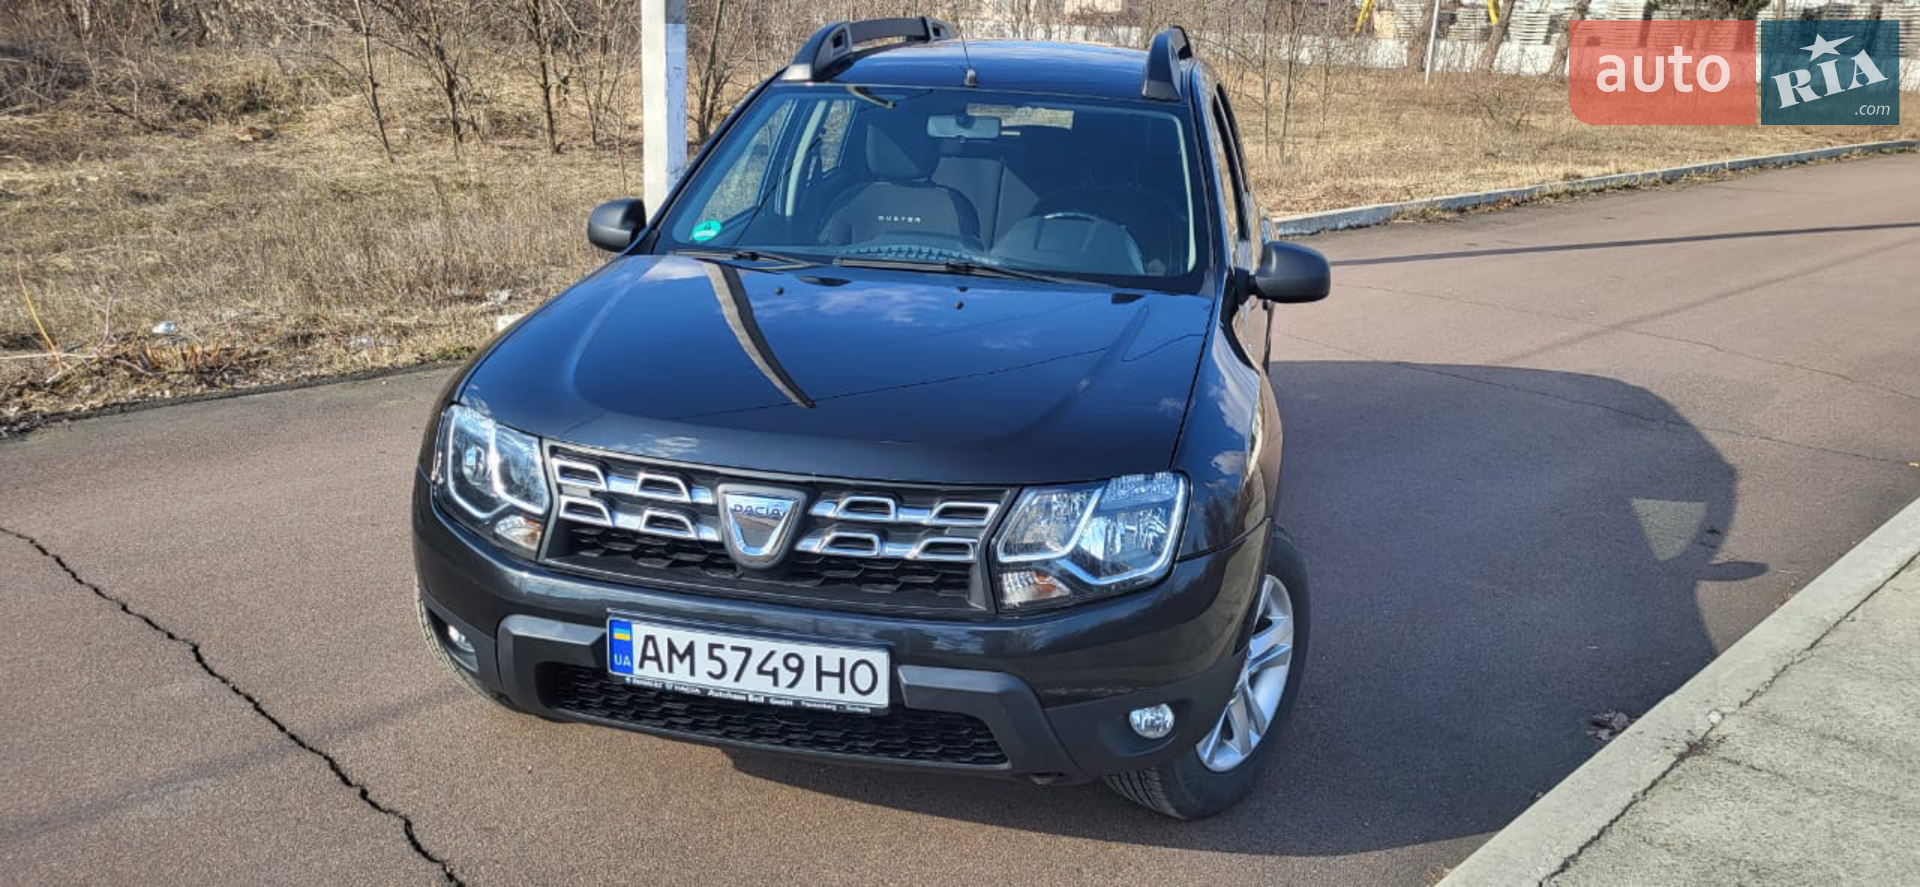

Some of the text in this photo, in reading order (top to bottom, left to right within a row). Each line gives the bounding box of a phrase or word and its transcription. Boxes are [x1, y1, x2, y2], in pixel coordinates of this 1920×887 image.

[733, 504, 781, 517] DACIA
[614, 653, 632, 667] UA
[638, 634, 879, 697] AM 5749 HO
